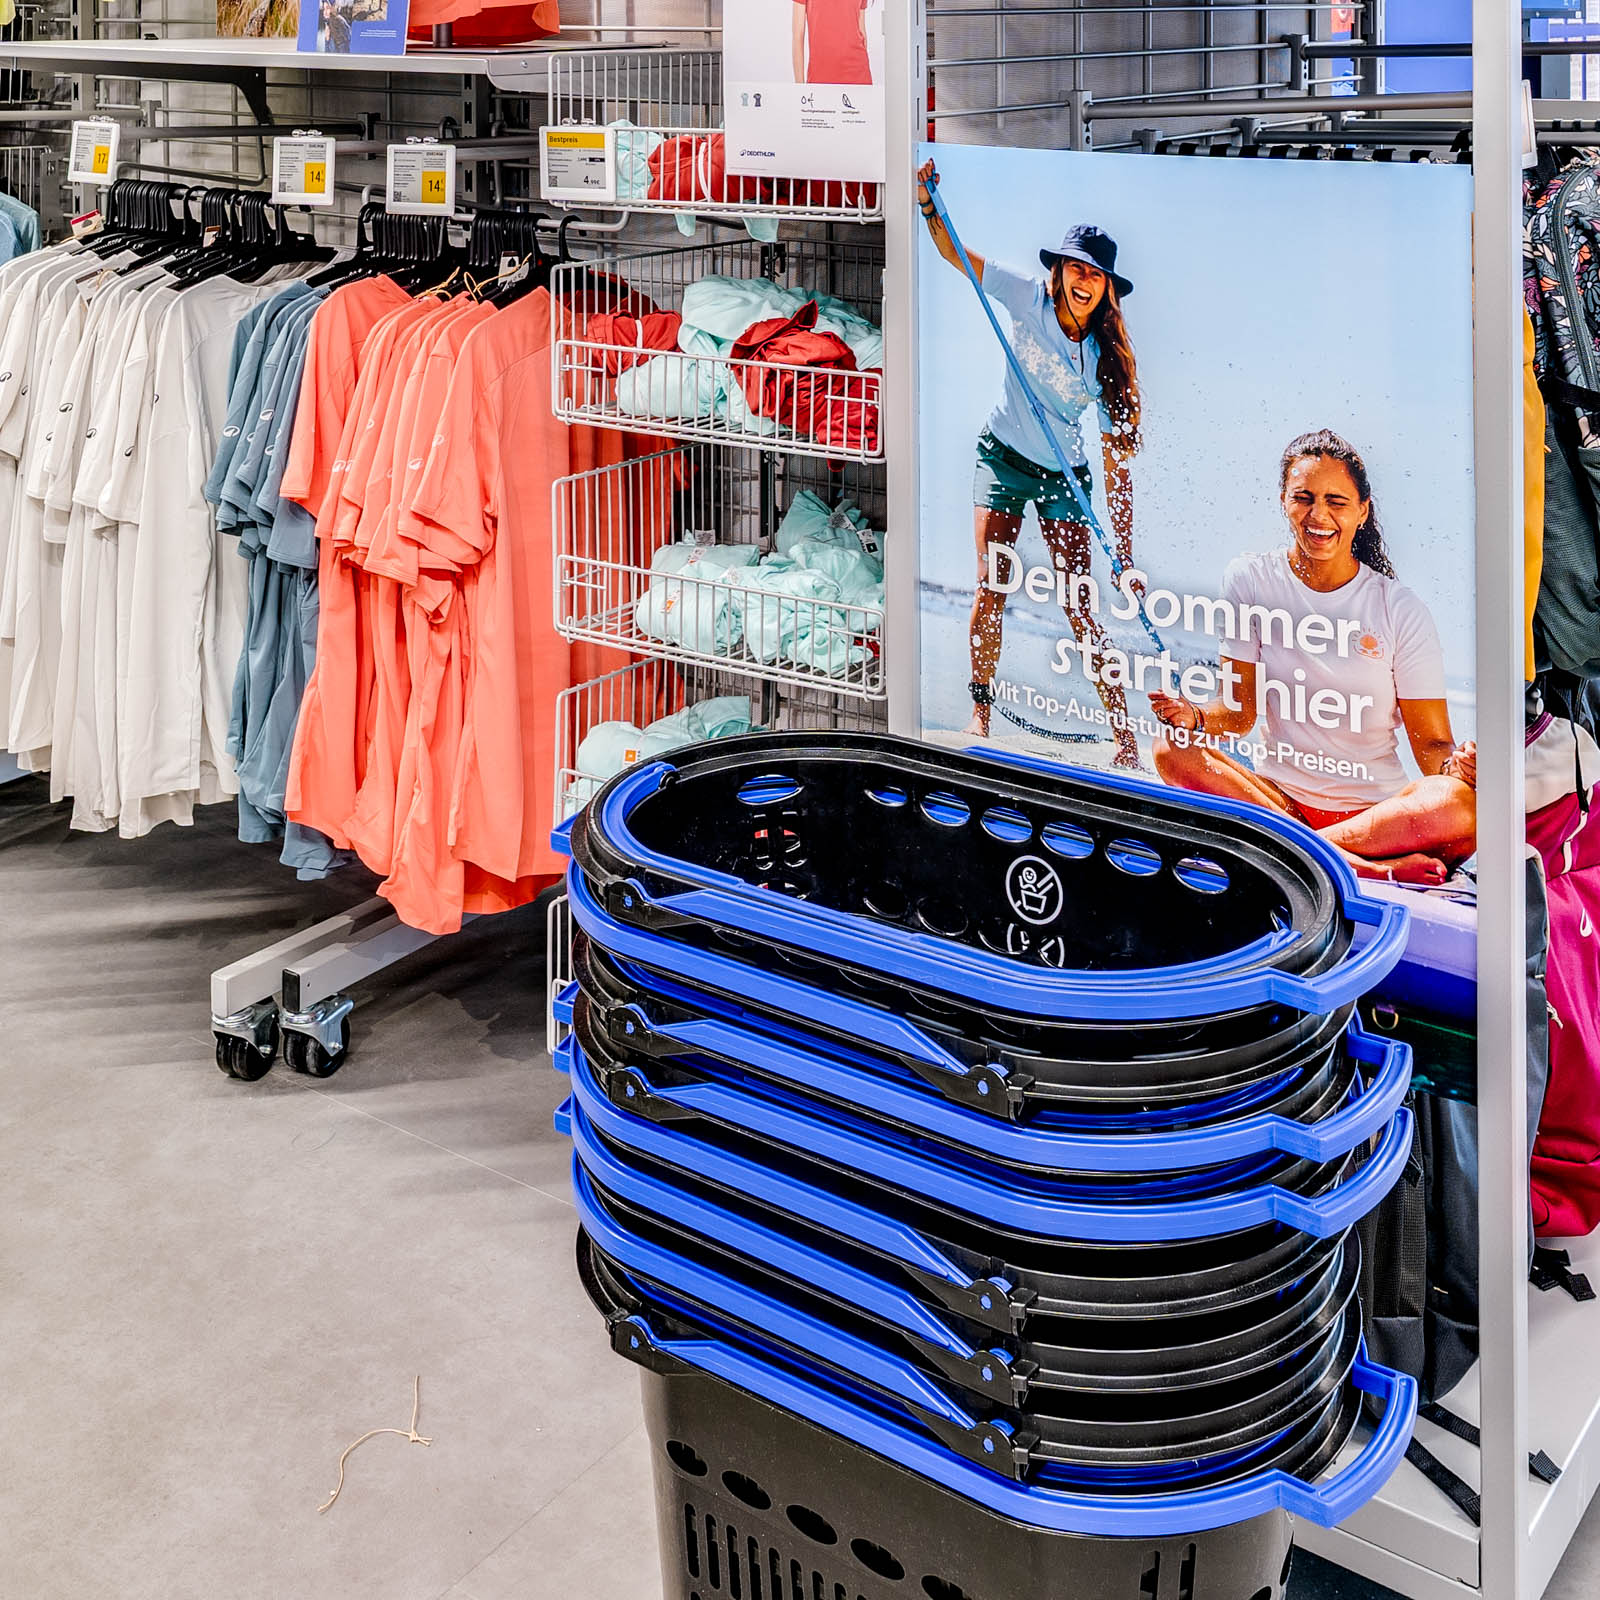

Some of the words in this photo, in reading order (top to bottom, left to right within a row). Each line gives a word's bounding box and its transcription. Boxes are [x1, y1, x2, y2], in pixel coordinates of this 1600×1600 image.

[987, 540, 1100, 614] Dein
[1111, 569, 1363, 658] Sommer
[988, 677, 1019, 700] Mit
[1022, 684, 1192, 749] Top-Ausrüstung
[1193, 728, 1222, 751] zu
[1223, 732, 1376, 782] Top-Preisen.
[1050, 634, 1250, 712] startet
[1252, 661, 1374, 734] hier
